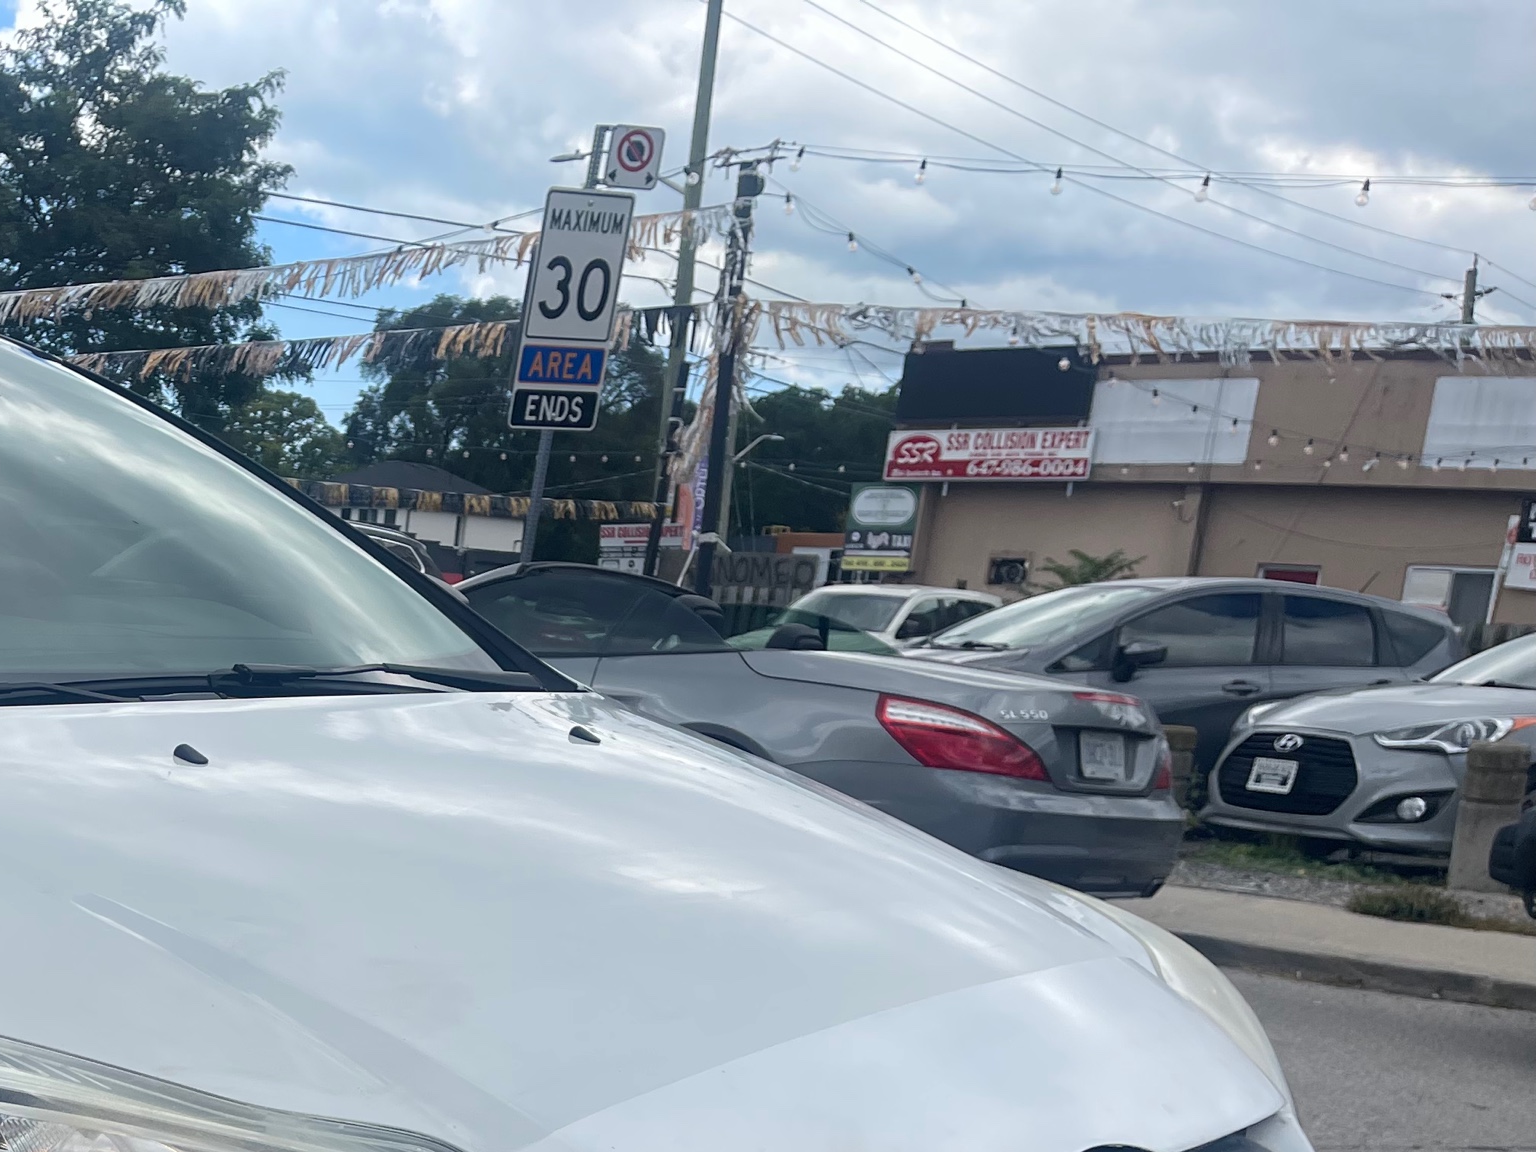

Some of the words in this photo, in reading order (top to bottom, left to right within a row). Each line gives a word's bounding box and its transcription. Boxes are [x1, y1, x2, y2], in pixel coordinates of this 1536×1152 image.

[549, 207, 626, 234] MAXIMUM
[538, 255, 611, 321] 30
[528, 351, 593, 380] AREA
[524, 394, 584, 423] ENDS
[897, 441, 938, 464] SSR
[947, 433, 971, 451] SSR
[974, 431, 1038, 450] COLLISION
[1041, 431, 1090, 450] EXPERT
